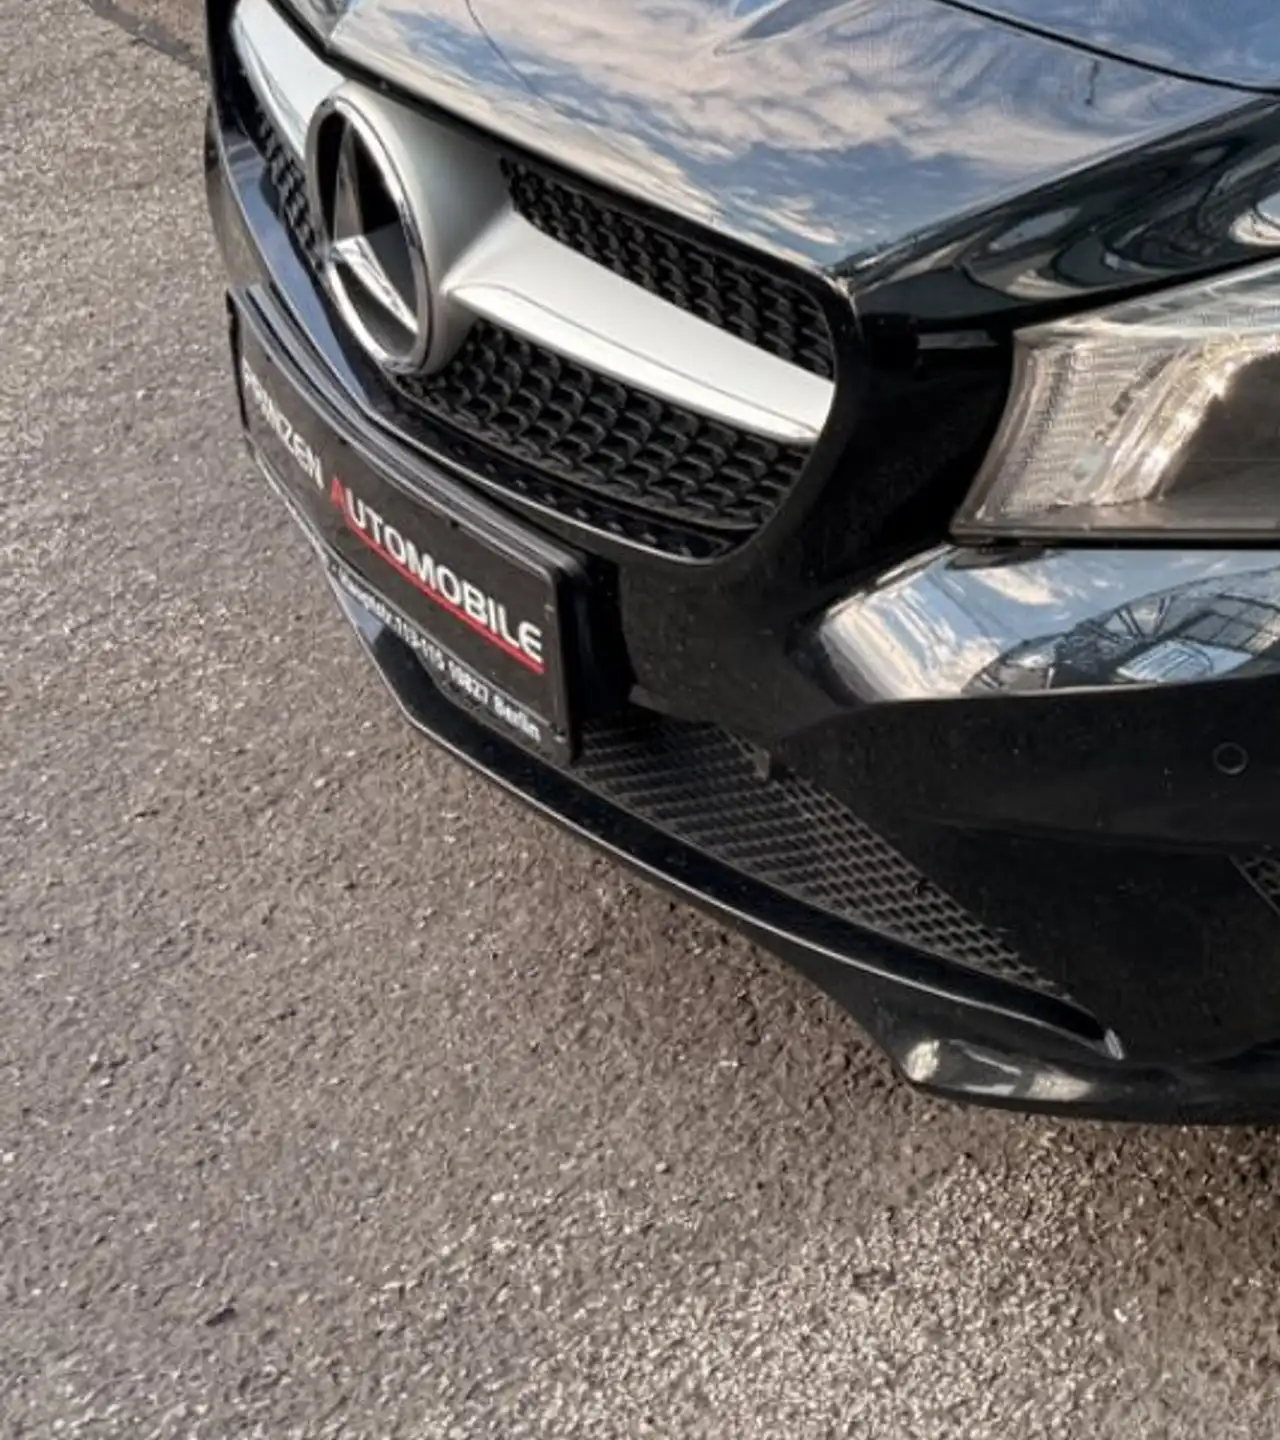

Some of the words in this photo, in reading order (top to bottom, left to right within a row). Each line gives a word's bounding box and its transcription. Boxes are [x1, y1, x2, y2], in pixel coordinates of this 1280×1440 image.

[242, 356, 325, 490] PRINZEN
[330, 476, 545, 666] AUTOMOBILE
[494, 694, 541, 742] Berlin
